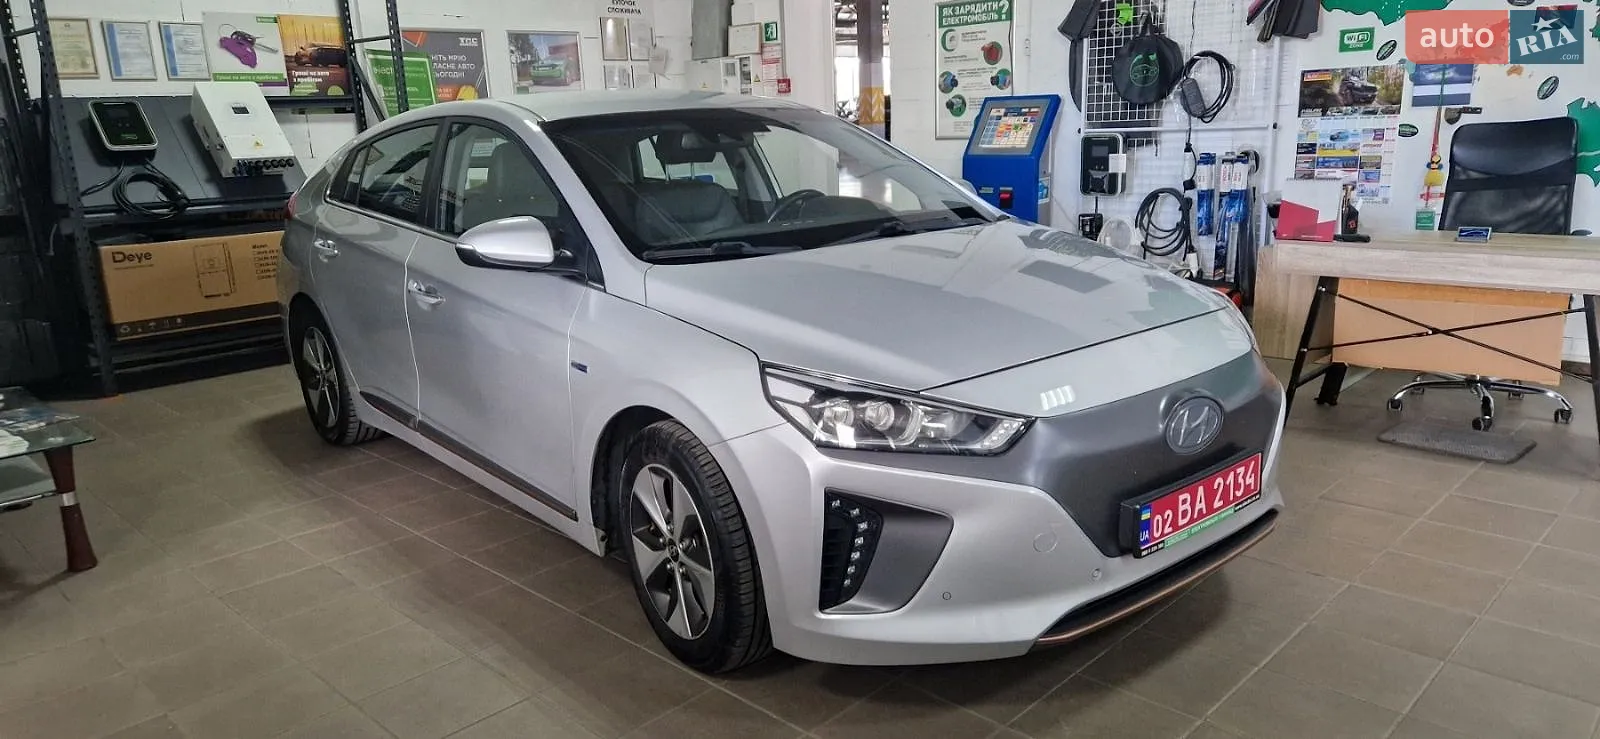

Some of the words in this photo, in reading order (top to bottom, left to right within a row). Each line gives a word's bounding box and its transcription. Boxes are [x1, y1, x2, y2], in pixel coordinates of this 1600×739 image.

[943, 6, 953, 17] ЯК
[954, 1, 999, 15] ЗАРЯДИТИ
[943, 12, 999, 26] ЕЛЕКТРОМОБІЛЬ
[111, 251, 153, 263] Deye
[1140, 530, 1149, 542] UA
[1153, 509, 1173, 538] 02
[1178, 485, 1207, 526] BA
[1213, 460, 1255, 509] 2134
